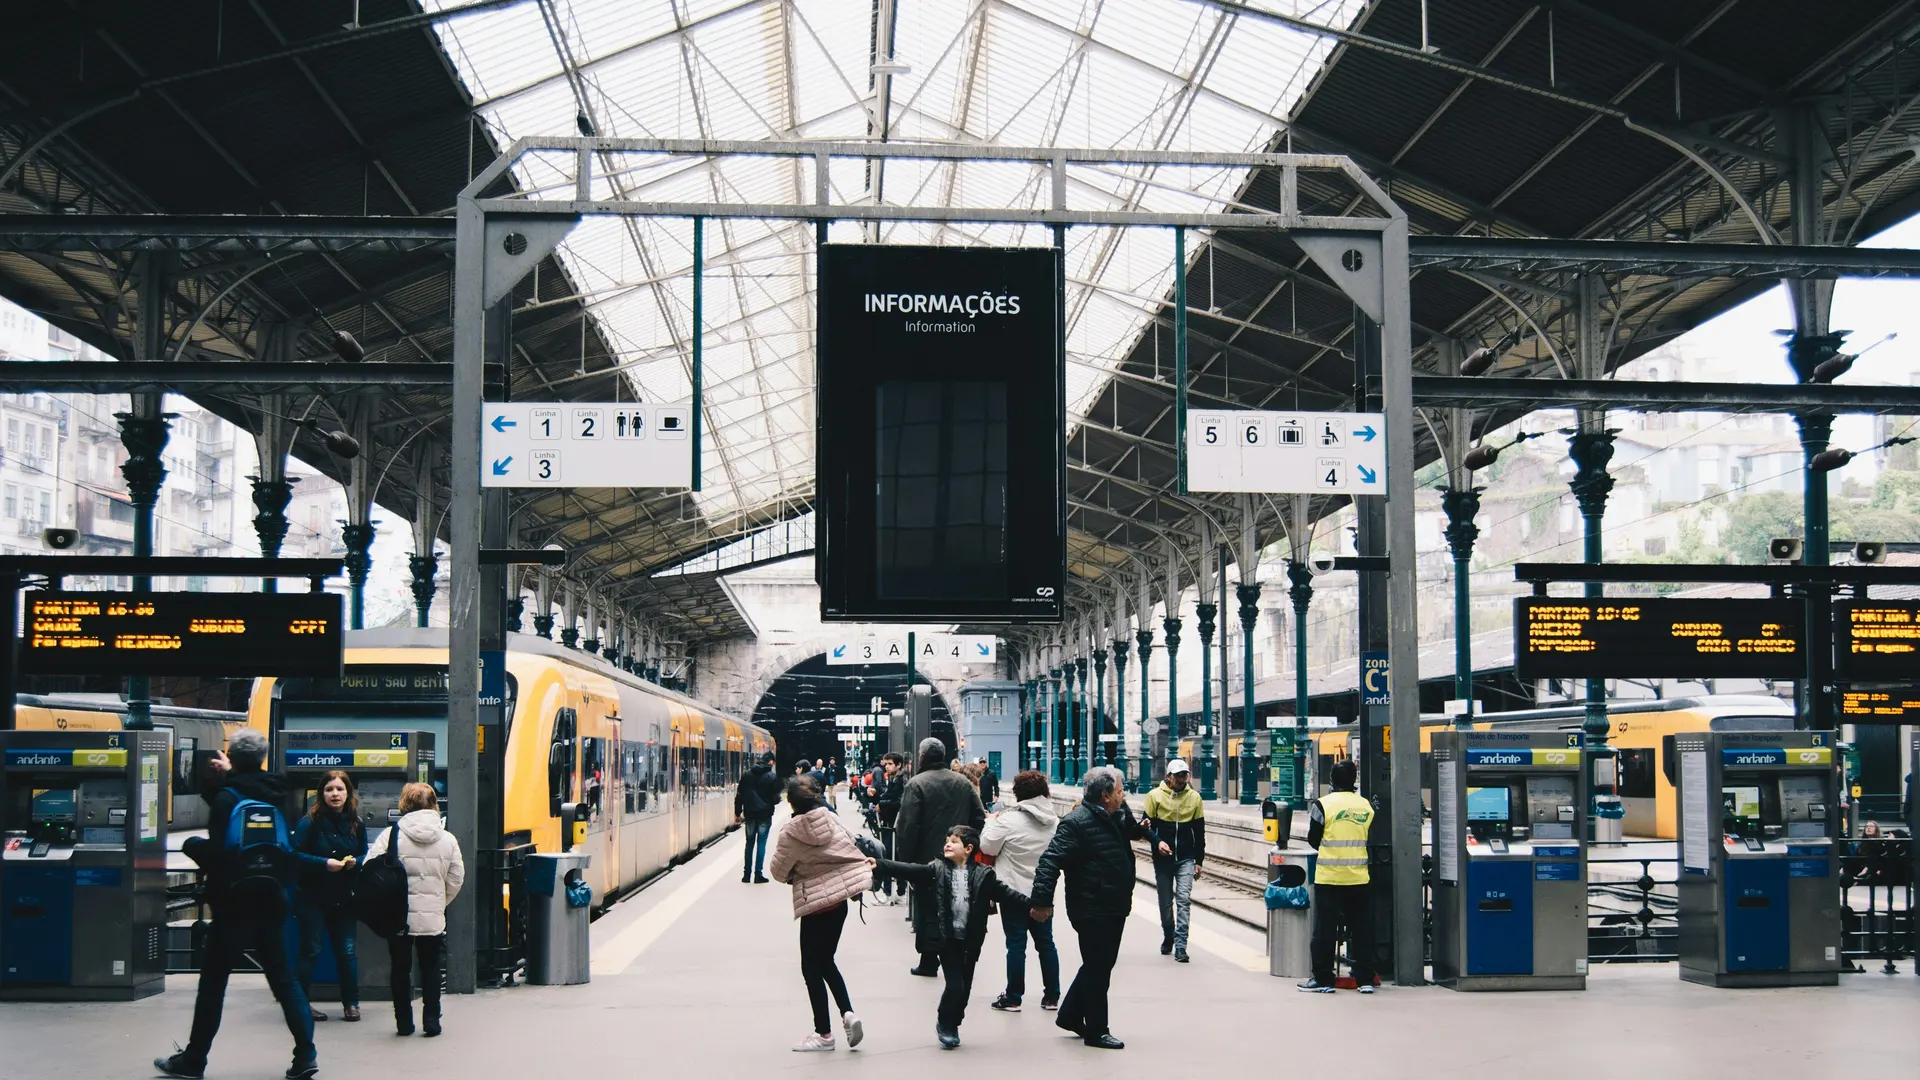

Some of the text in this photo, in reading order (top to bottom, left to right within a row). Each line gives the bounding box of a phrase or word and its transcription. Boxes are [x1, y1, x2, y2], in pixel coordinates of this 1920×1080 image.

[865, 291, 1021, 319] INFORMAÇÕES
[905, 320, 976, 333] Information
[535, 410, 599, 418] Linha Linha
[541, 418, 594, 437] 1 2
[1201, 417, 1262, 426] Linha Linha
[1206, 425, 1258, 444] 5 6
[534, 452, 556, 460] Linha
[538, 459, 552, 479] 3
[1321, 459, 1342, 467] Linha
[1325, 468, 1338, 486] 4
[32, 600, 101, 616] PARTIDA
[1529, 606, 1591, 621] PARTIDA
[1850, 608, 1911, 623] PARTIDA
[189, 619, 246, 634] SUBURB
[1529, 622, 1583, 637] AVEIRO
[114, 634, 182, 650] MEINEDO
[863, 643, 900, 659] 3 A
[923, 643, 960, 658] A 4
[340, 675, 378, 688] PORTO
[414, 675, 449, 688] BENT
[109, 737, 119, 747] C1
[391, 738, 402, 746] C1
[1567, 738, 1578, 747] C1
[1811, 737, 1822, 746] C1
[16, 753, 61, 765] andante
[297, 754, 341, 765] andante
[1479, 752, 1522, 764] andante
[1736, 752, 1777, 764] andante
